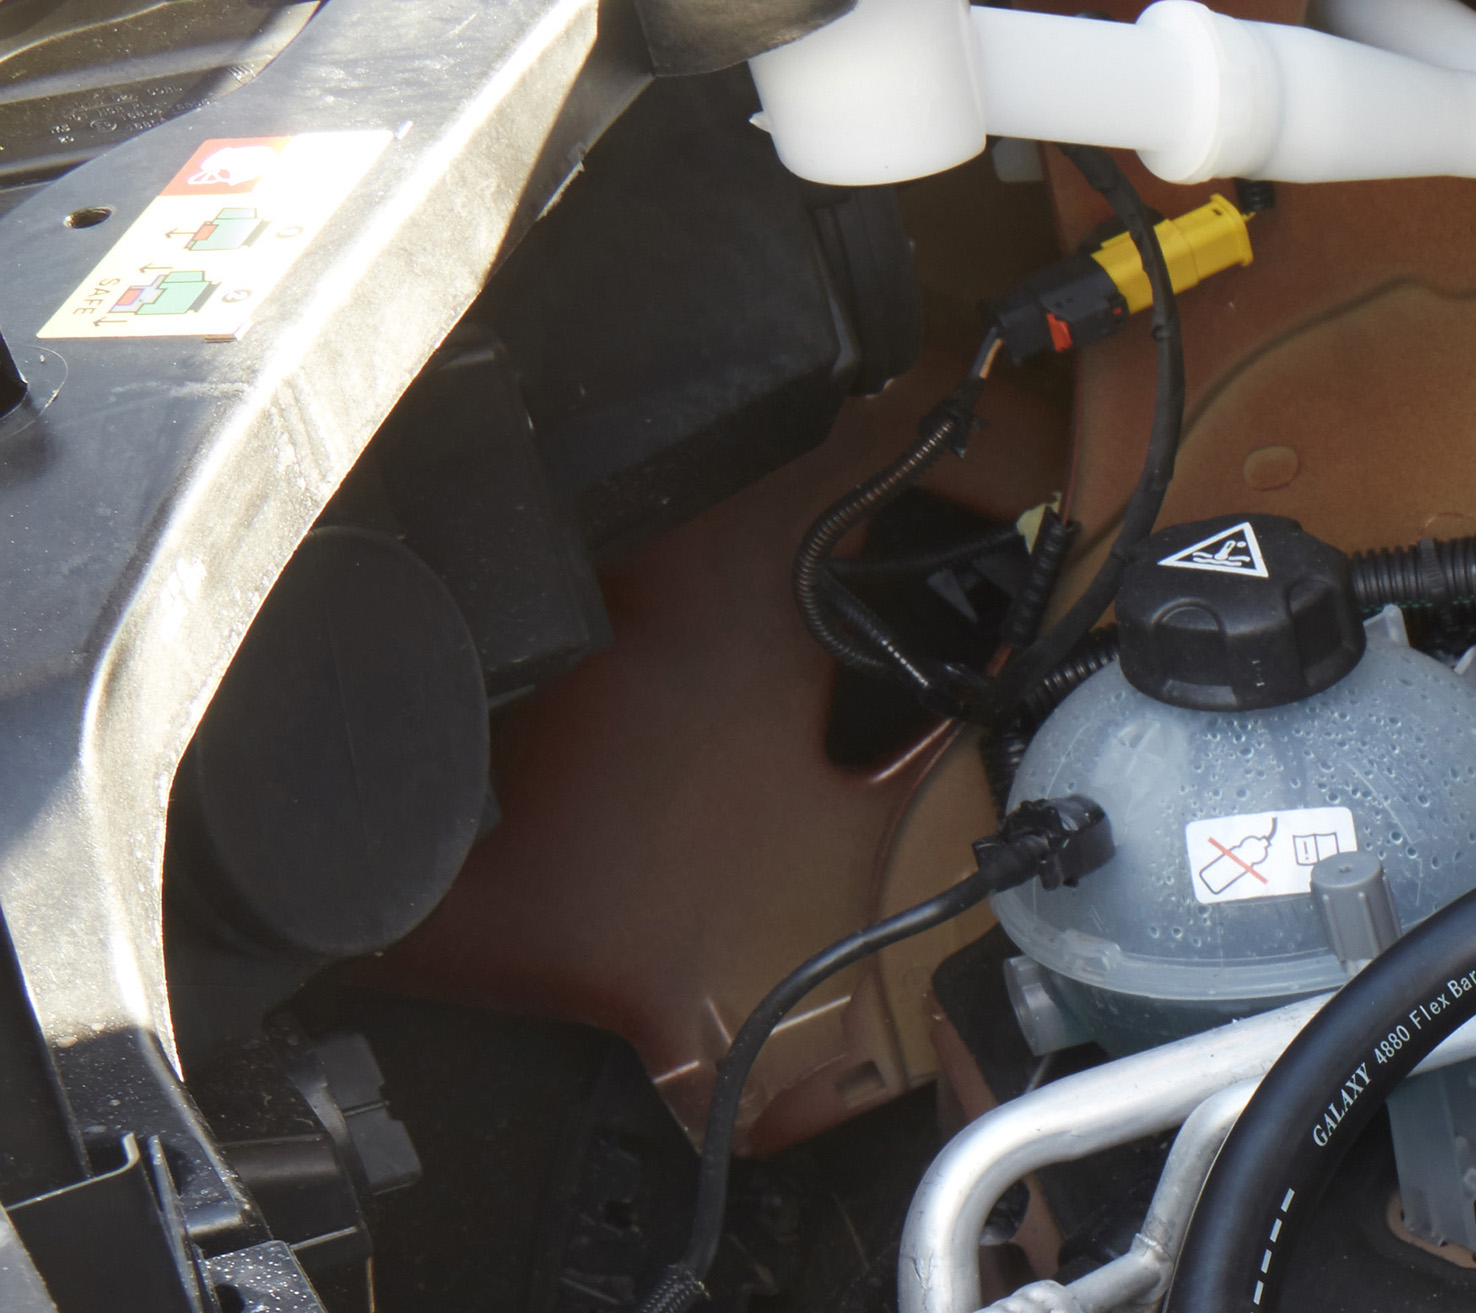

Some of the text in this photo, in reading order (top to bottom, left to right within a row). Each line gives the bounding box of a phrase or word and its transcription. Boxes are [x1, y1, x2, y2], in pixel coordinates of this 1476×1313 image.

[72, 278, 121, 315] SAFE
[1312, 1063, 1373, 1147] GALAXY
[1373, 1025, 1411, 1065] 4880
[1408, 994, 1451, 1030] Flex
